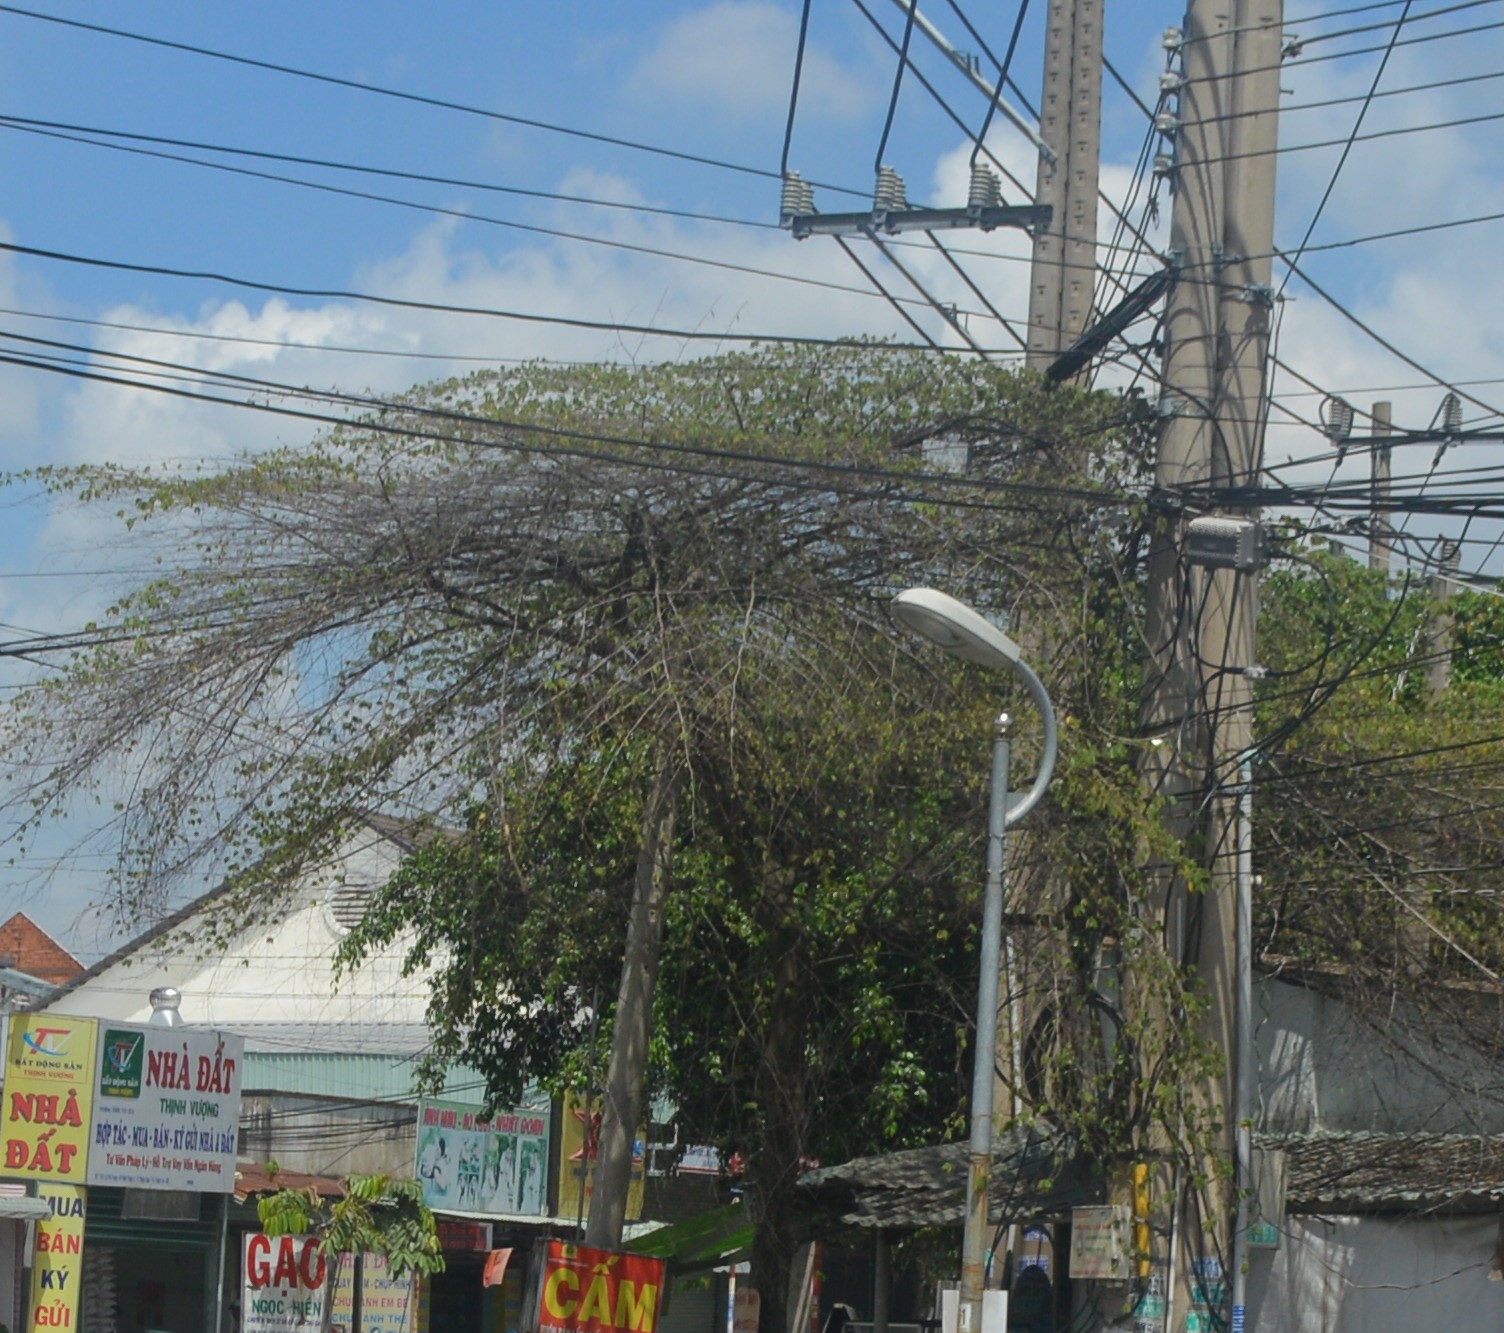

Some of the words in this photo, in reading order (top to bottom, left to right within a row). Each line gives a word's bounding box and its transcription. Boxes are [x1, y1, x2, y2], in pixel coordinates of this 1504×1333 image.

[145, 1042, 190, 1091] NHÀ
[195, 1041, 235, 1095] ĐẤT
[10, 1087, 83, 1128] NHÀ
[160, 1097, 187, 1118] THỊNH
[5, 1128, 77, 1174] ĐẤT
[37, 1228, 81, 1254] BÁN
[41, 1265, 69, 1290] KÝ
[247, 1234, 326, 1297] GẠO
[251, 1299, 284, 1316] NGỌC
[544, 1255, 658, 1333] CẤM
[35, 1298, 70, 1328] GỬI
